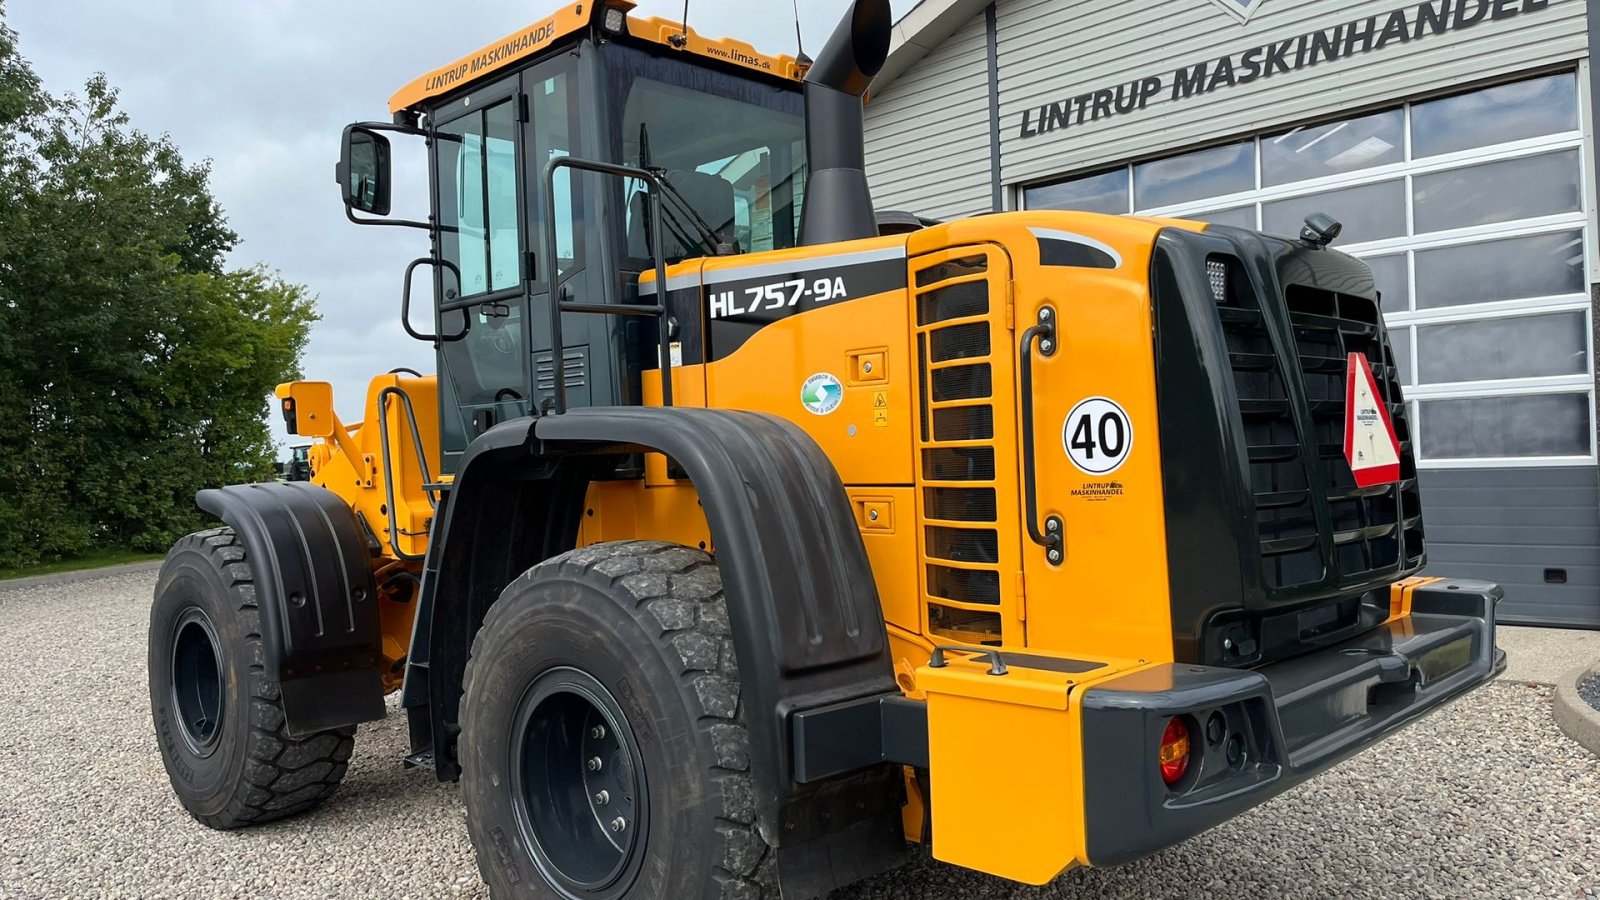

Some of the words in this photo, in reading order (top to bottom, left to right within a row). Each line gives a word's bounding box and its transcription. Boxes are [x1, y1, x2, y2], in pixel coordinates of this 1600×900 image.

[707, 46, 771, 70] www.limas.dk
[425, 64, 468, 91] LINTRUP
[1020, 76, 1162, 138] LINTRUP
[710, 277, 847, 319] HL757-9A
[1071, 411, 1124, 459] 40
[1071, 488, 1124, 496] MASKINHANDEL
